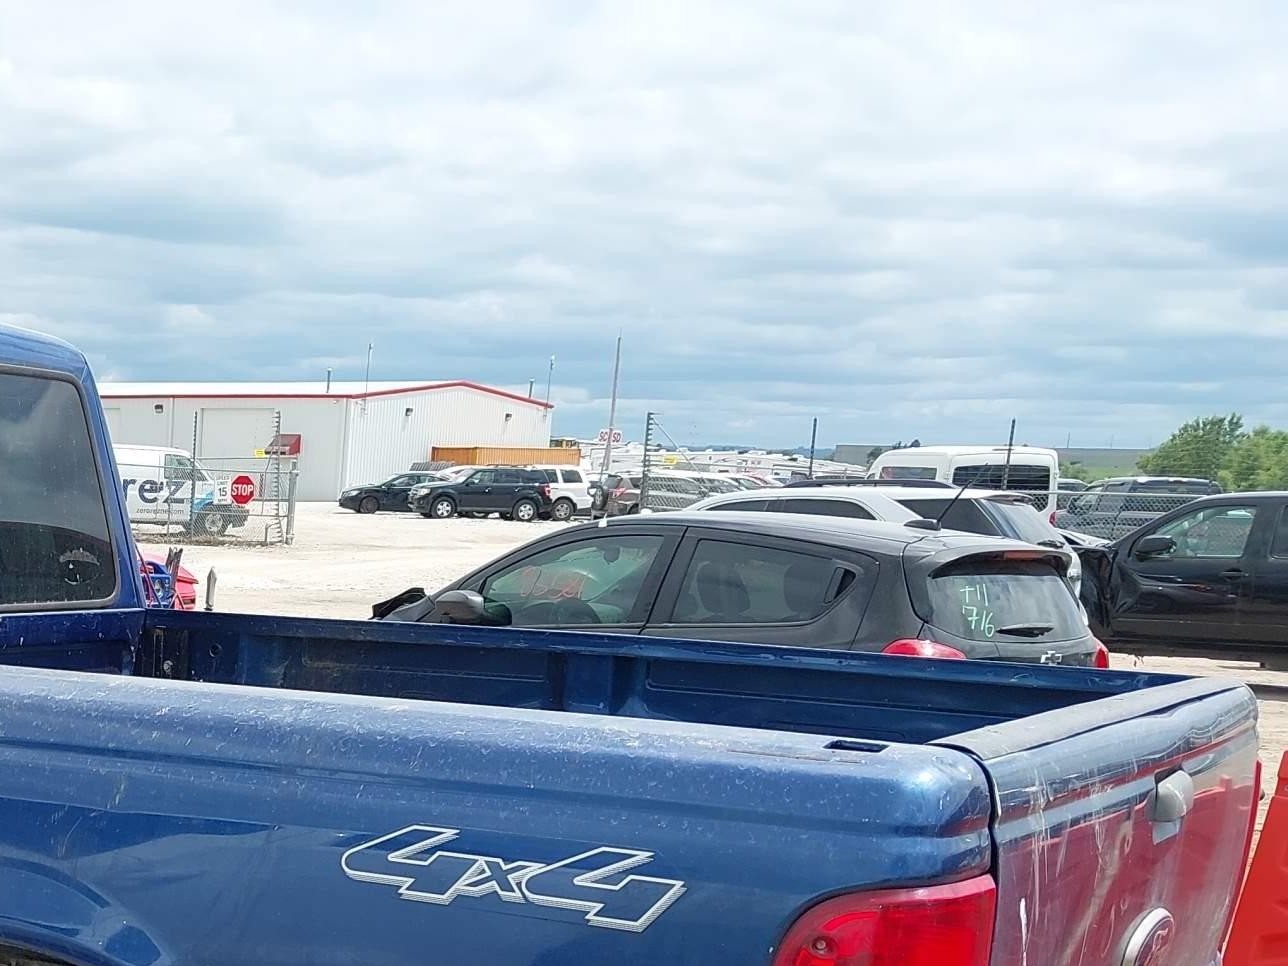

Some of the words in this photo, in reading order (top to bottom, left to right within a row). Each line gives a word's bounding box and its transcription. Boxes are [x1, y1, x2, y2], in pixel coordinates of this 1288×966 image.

[218, 487, 227, 497] 15
[231, 484, 254, 496] STOP
[341, 824, 687, 933] 4x4
